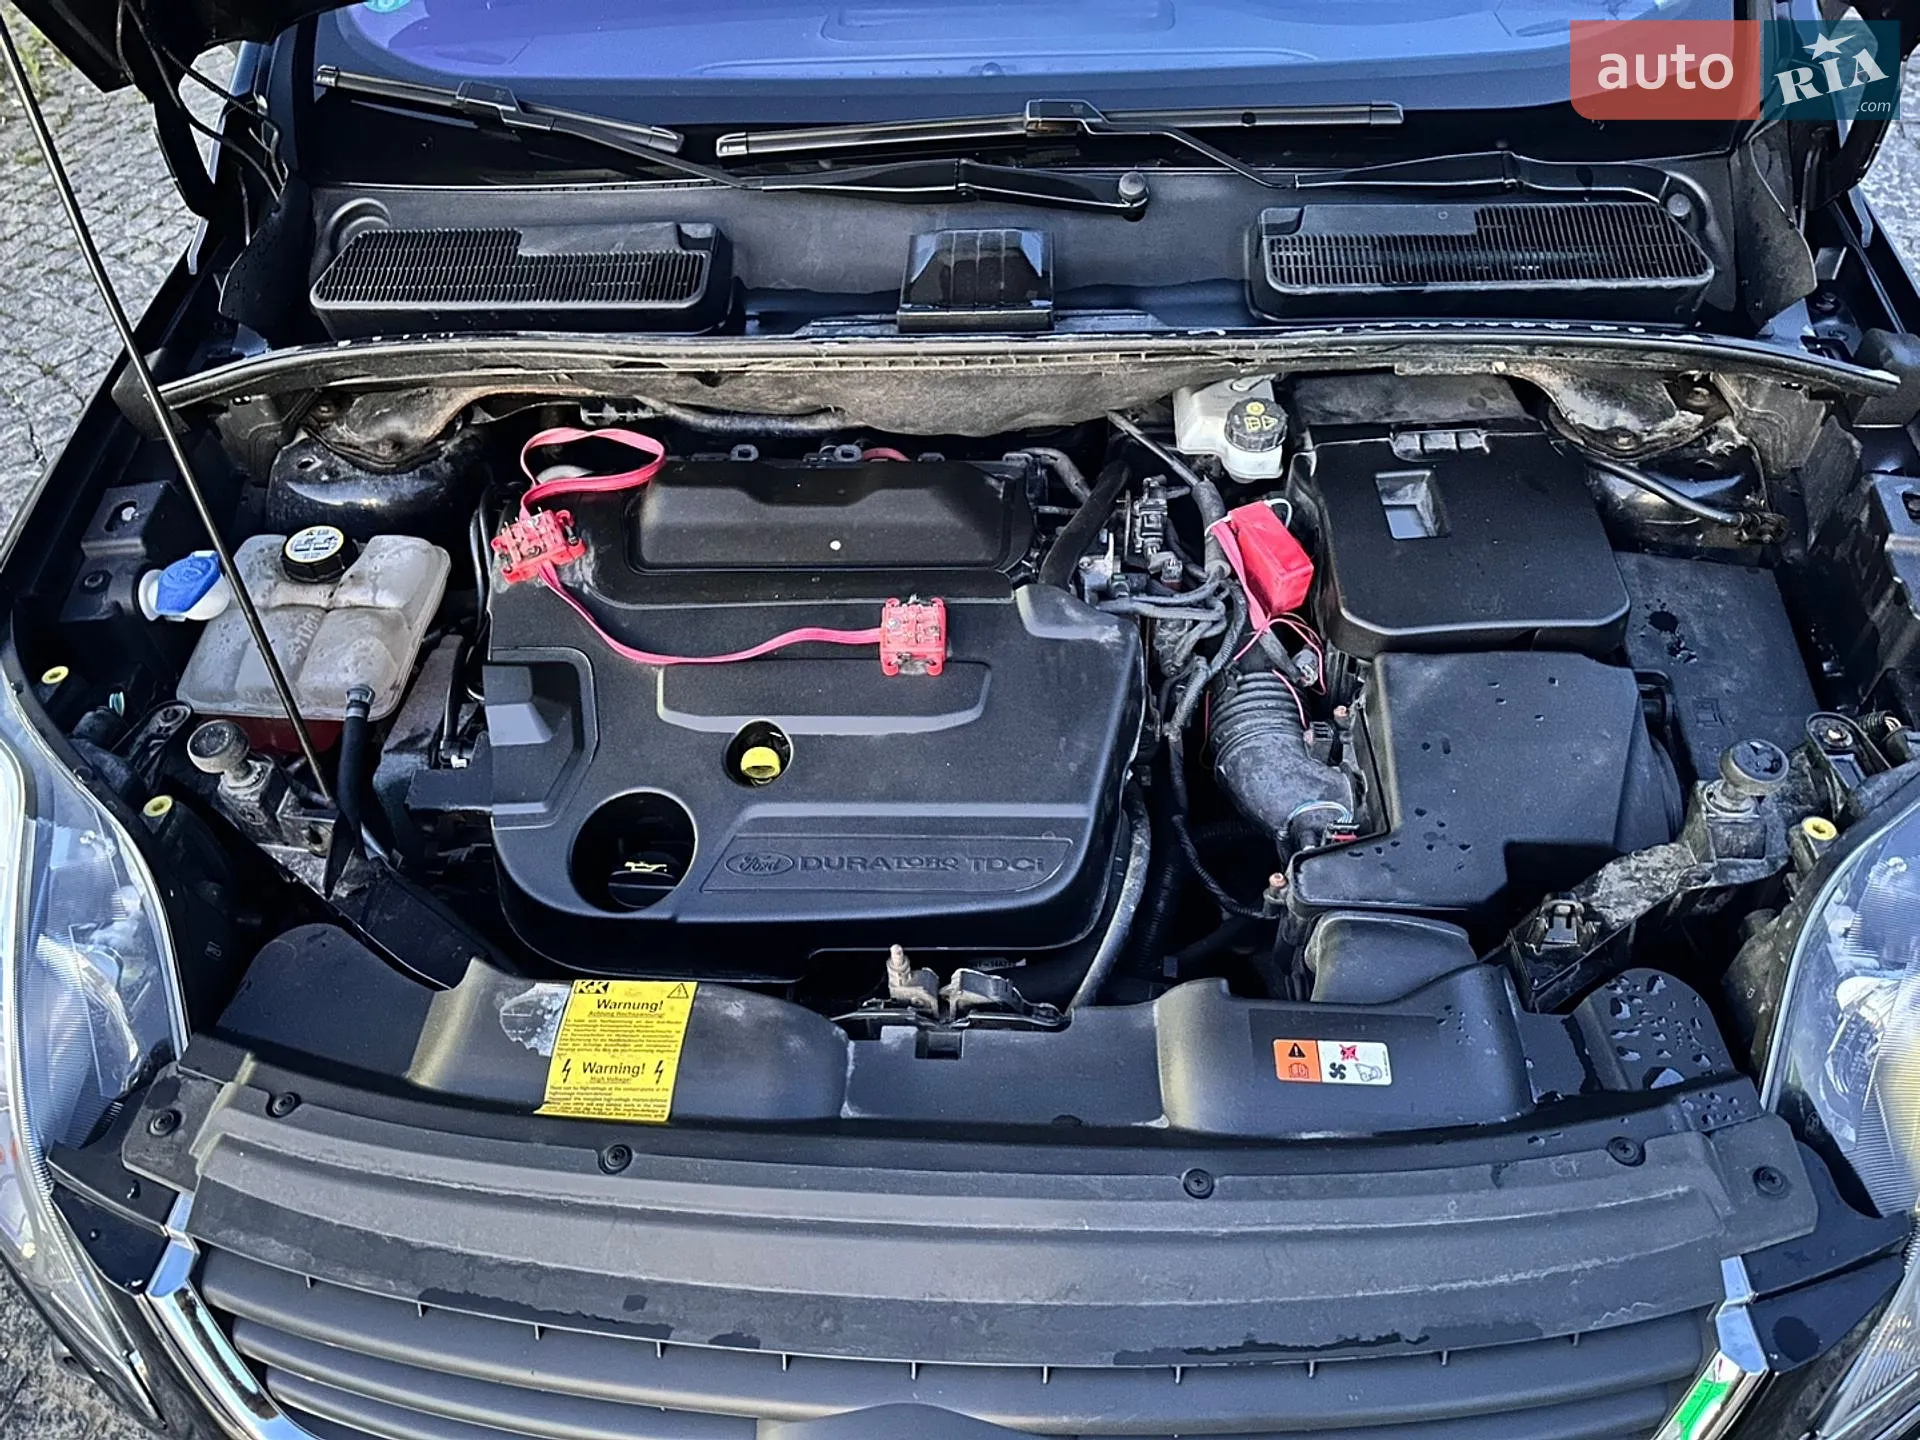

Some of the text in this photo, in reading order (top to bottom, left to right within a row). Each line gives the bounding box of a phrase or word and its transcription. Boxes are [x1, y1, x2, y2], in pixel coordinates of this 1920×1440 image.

[798, 855, 959, 872] DURATORQ
[967, 855, 1044, 873] TDCi
[597, 999, 664, 1013] Warnung!
[582, 1061, 646, 1077] Warning!
